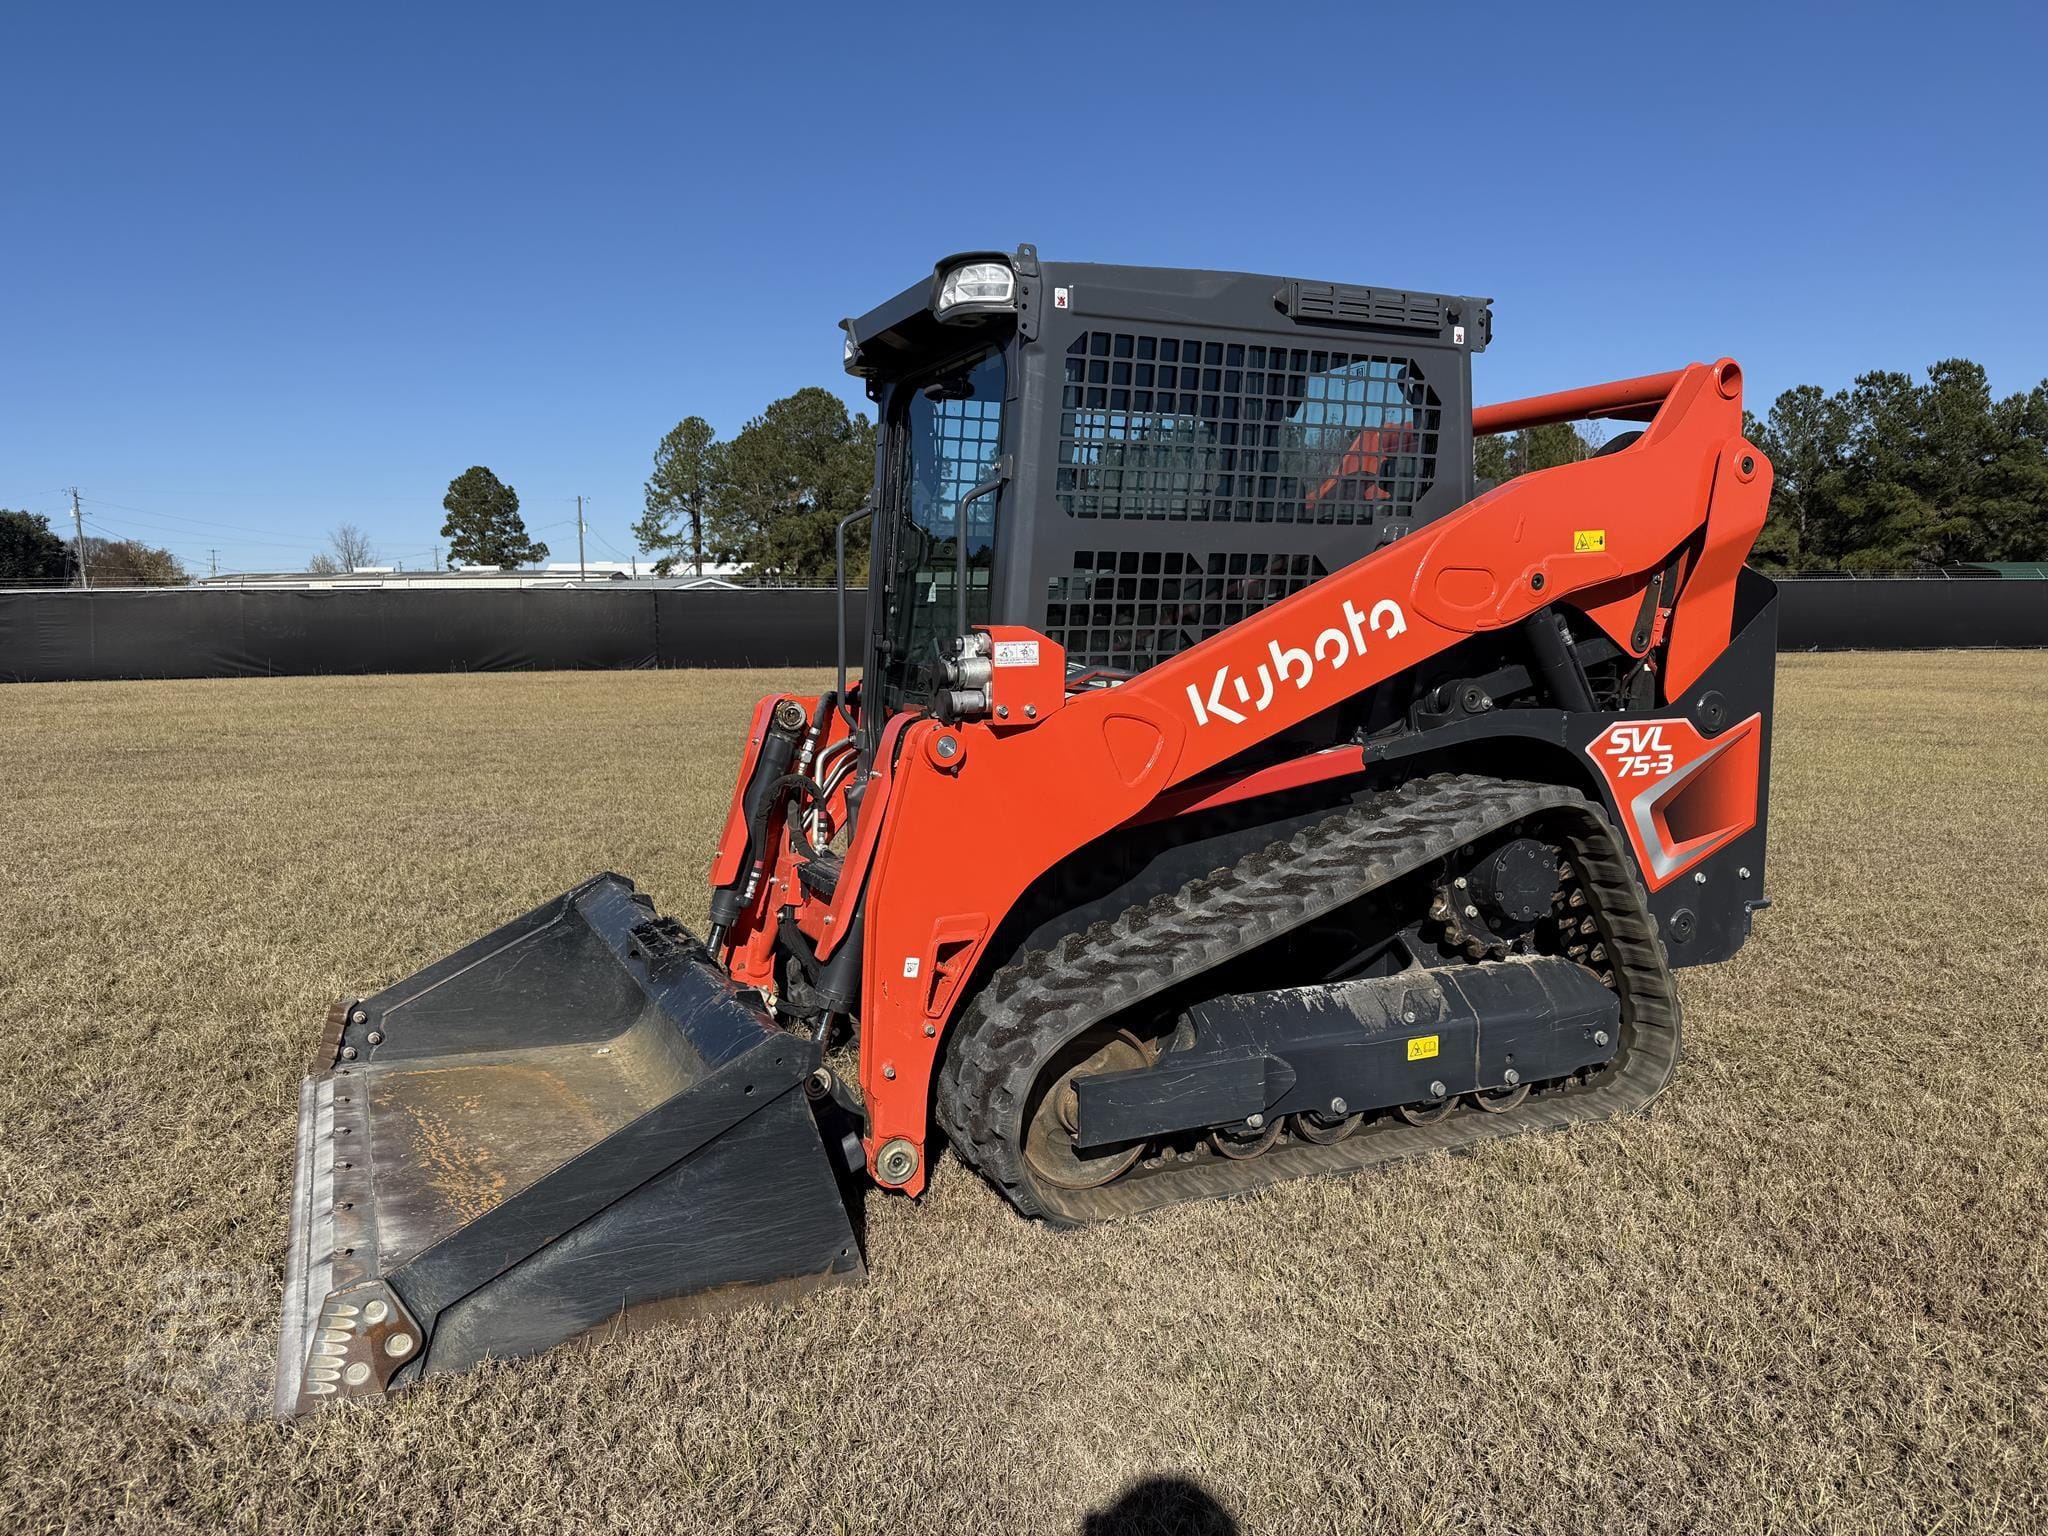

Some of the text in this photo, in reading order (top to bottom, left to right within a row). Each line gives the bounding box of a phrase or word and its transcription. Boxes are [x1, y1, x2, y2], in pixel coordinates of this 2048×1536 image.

[1186, 599, 1408, 727] Kubota
[1606, 726, 1673, 755] SVL
[1617, 754, 1674, 778] 75-3
